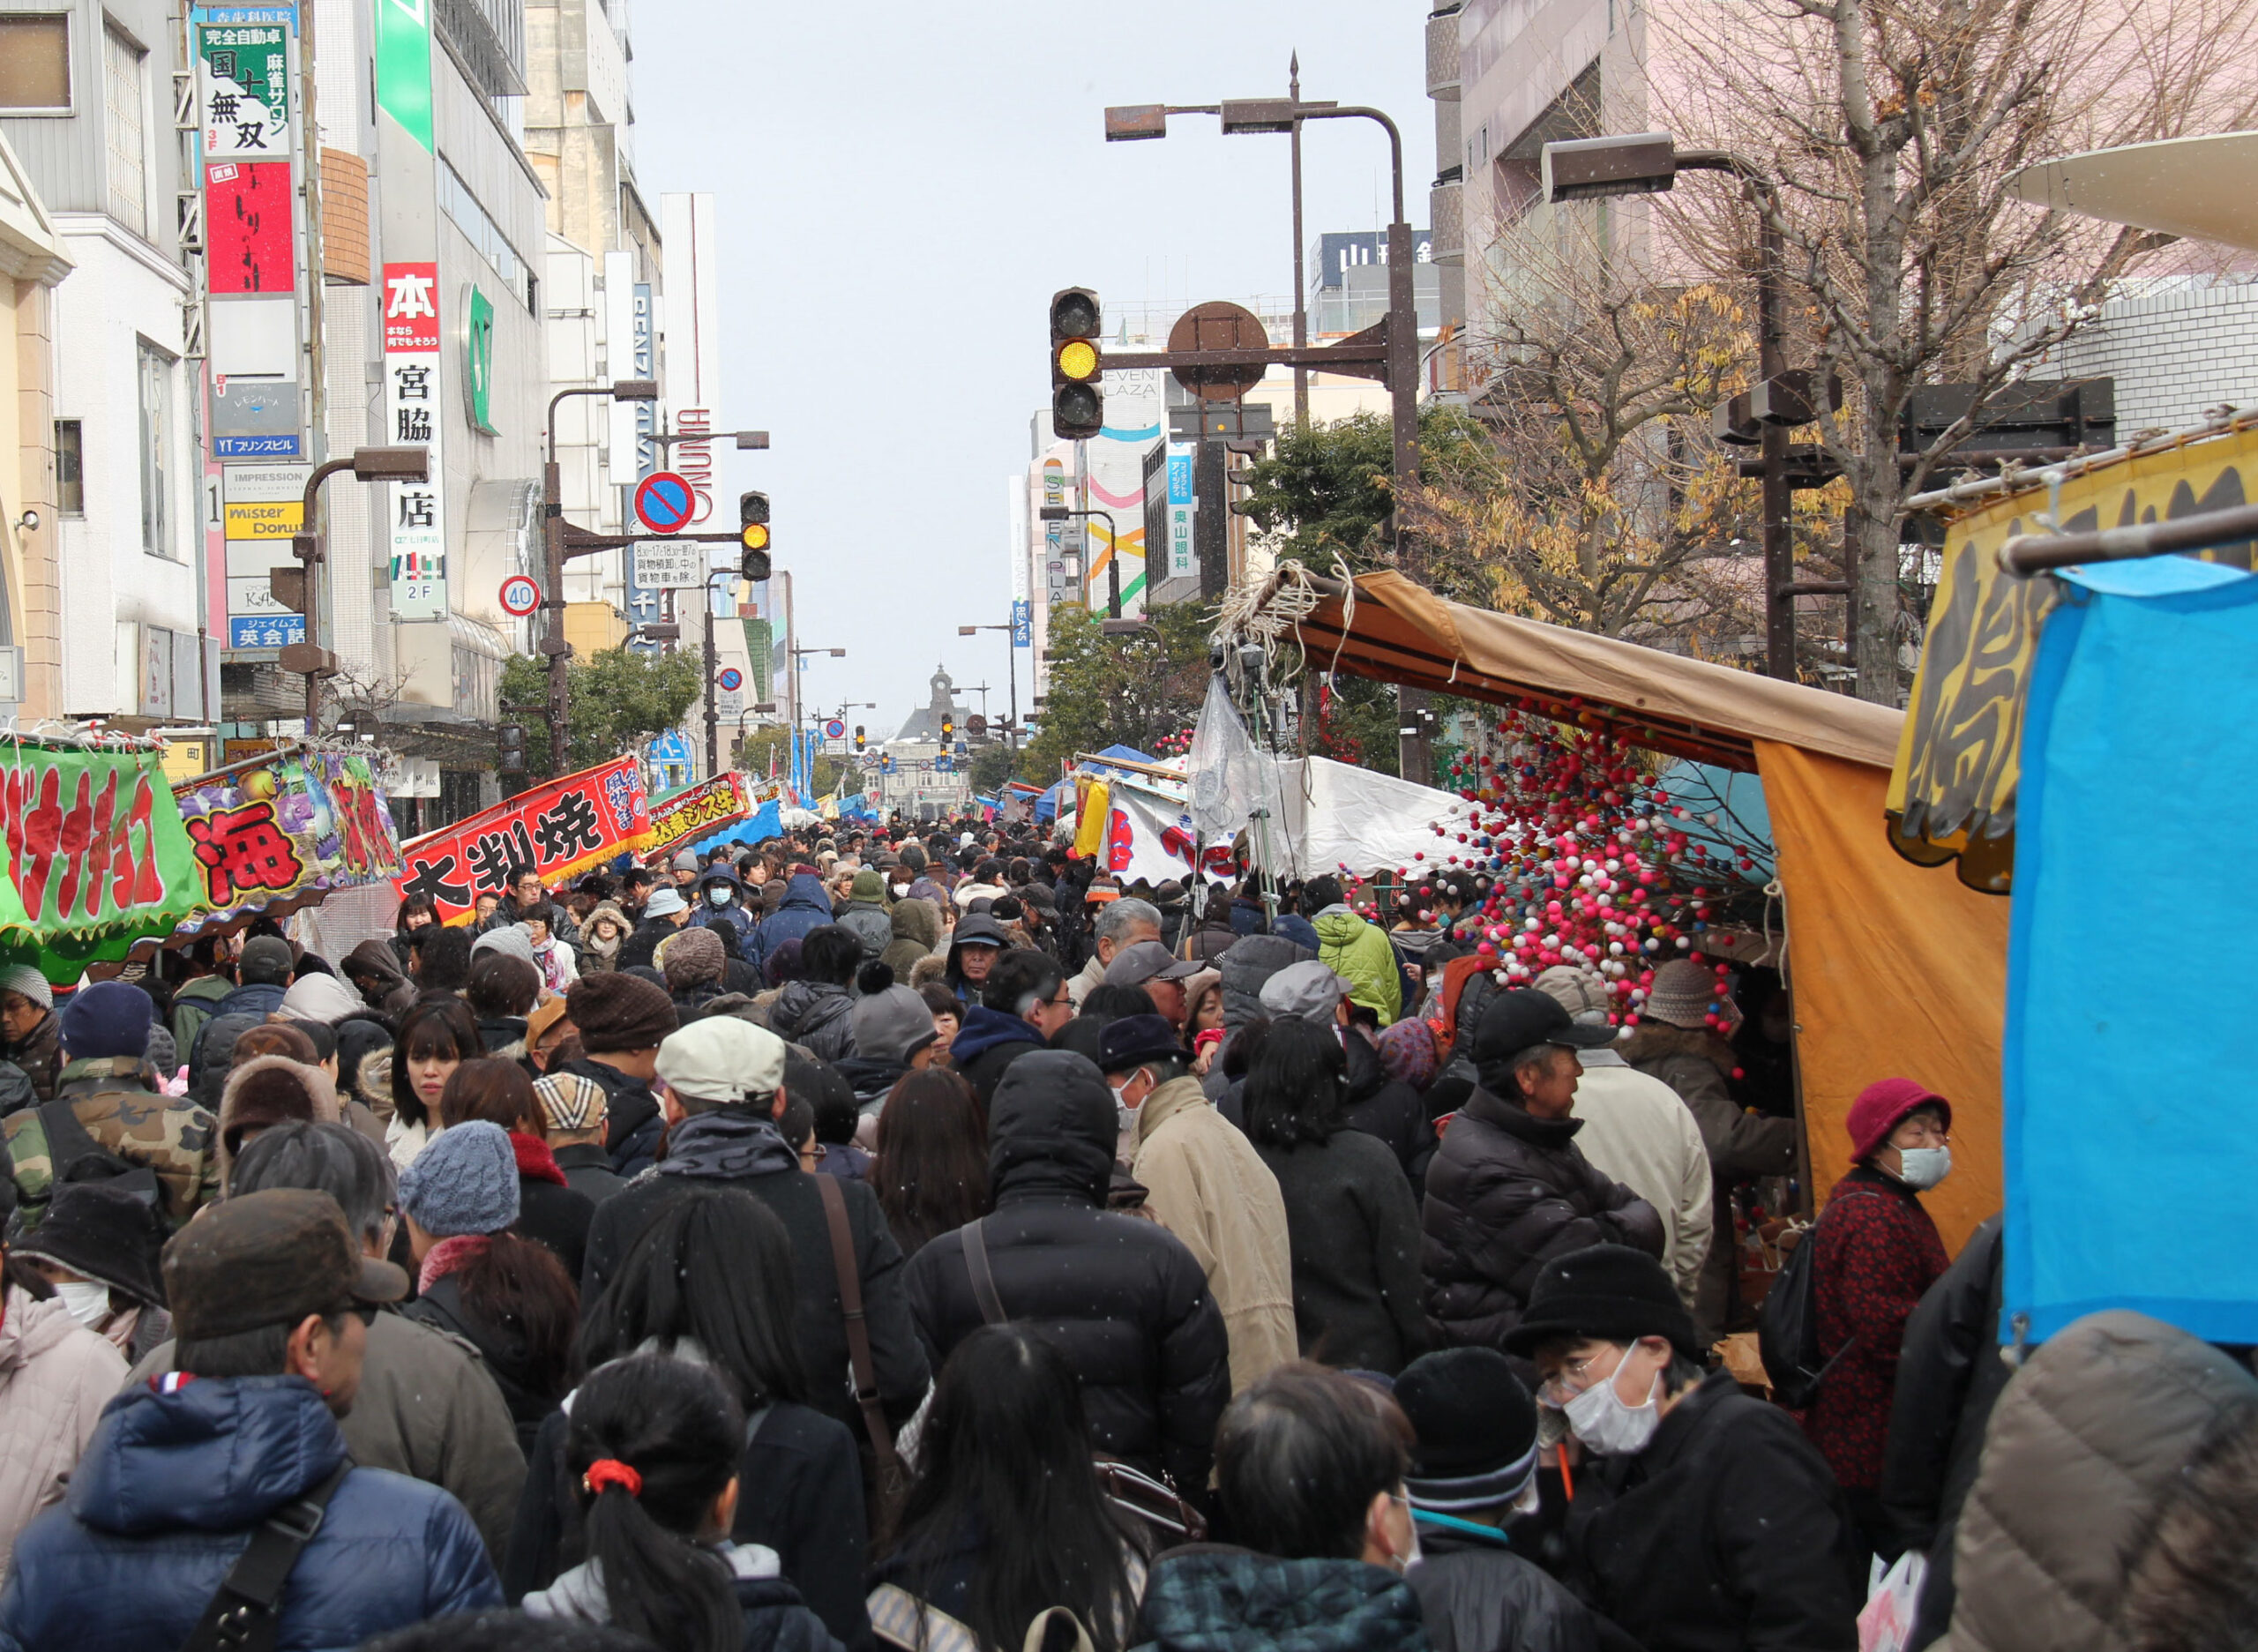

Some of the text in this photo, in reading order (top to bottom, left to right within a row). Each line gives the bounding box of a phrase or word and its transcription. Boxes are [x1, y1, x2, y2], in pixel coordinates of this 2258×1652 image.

[206, 28, 281, 45] 完全自動卓
[206, 50, 267, 148] 国士無双
[266, 53, 286, 136] 麻雀サロン
[208, 129, 217, 151] 3F
[387, 273, 436, 319] 本
[386, 325, 414, 336] 本なら
[387, 336, 438, 348] 何でもそろう
[216, 373, 227, 395] B1
[1103, 370, 1155, 382] EVEN
[1103, 384, 1157, 397] LAZA
[219, 439, 294, 452] YT プリンスビル
[394, 364, 435, 528] 宮脇店
[234, 472, 303, 482] IMPRESSION
[208, 483, 220, 522] 1
[1047, 475, 1060, 550] SEEN
[229, 507, 285, 520] mister
[1174, 510, 1188, 569] 奥山眼科
[638, 572, 696, 584] 貨物車を除く
[509, 587, 531, 605] 40
[247, 618, 299, 629] ジェイムズ
[1015, 606, 1027, 641] BEANS
[239, 628, 305, 647] 英会話
[604, 768, 634, 831] 風物詩
[402, 789, 604, 908] 大判焼
